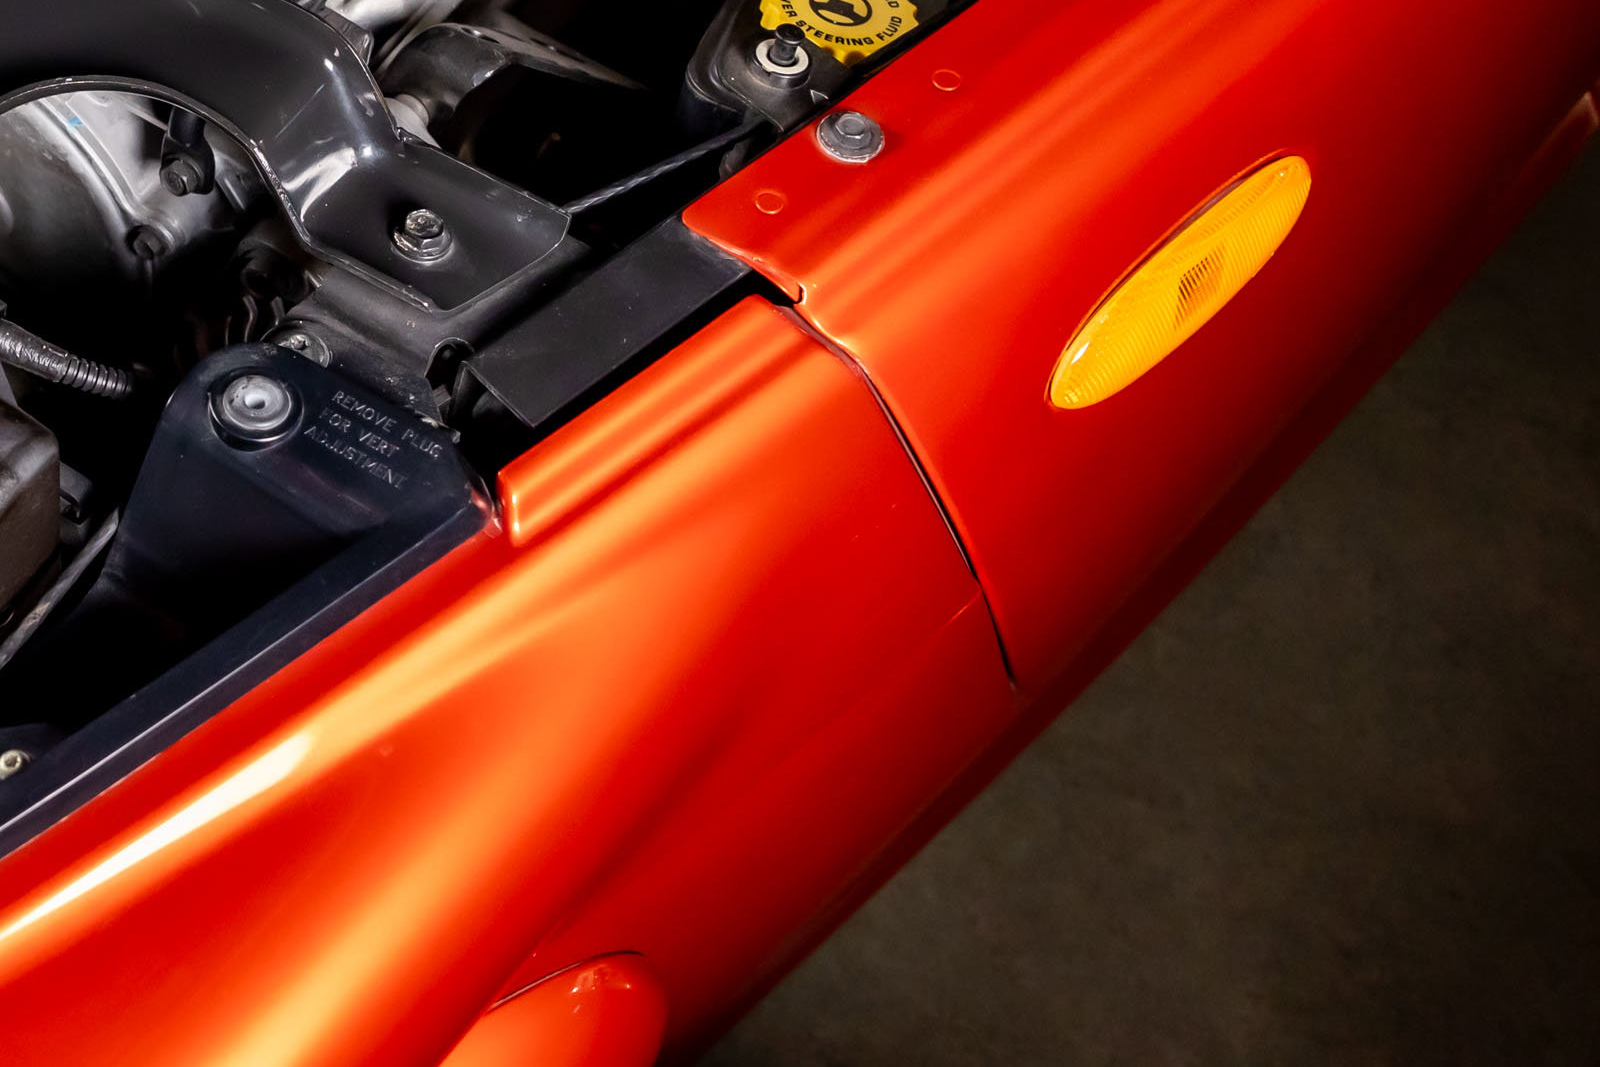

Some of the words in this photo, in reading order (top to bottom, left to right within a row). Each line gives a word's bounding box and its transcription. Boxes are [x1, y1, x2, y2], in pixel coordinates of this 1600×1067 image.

[795, 19, 875, 47] STEERING
[876, 16, 903, 41] FLUID
[318, 407, 352, 433] FOR
[359, 428, 400, 458] VERT
[332, 390, 397, 433] REMOVE
[401, 428, 443, 460] PLUG
[304, 426, 408, 488] ADJUSTMENT
